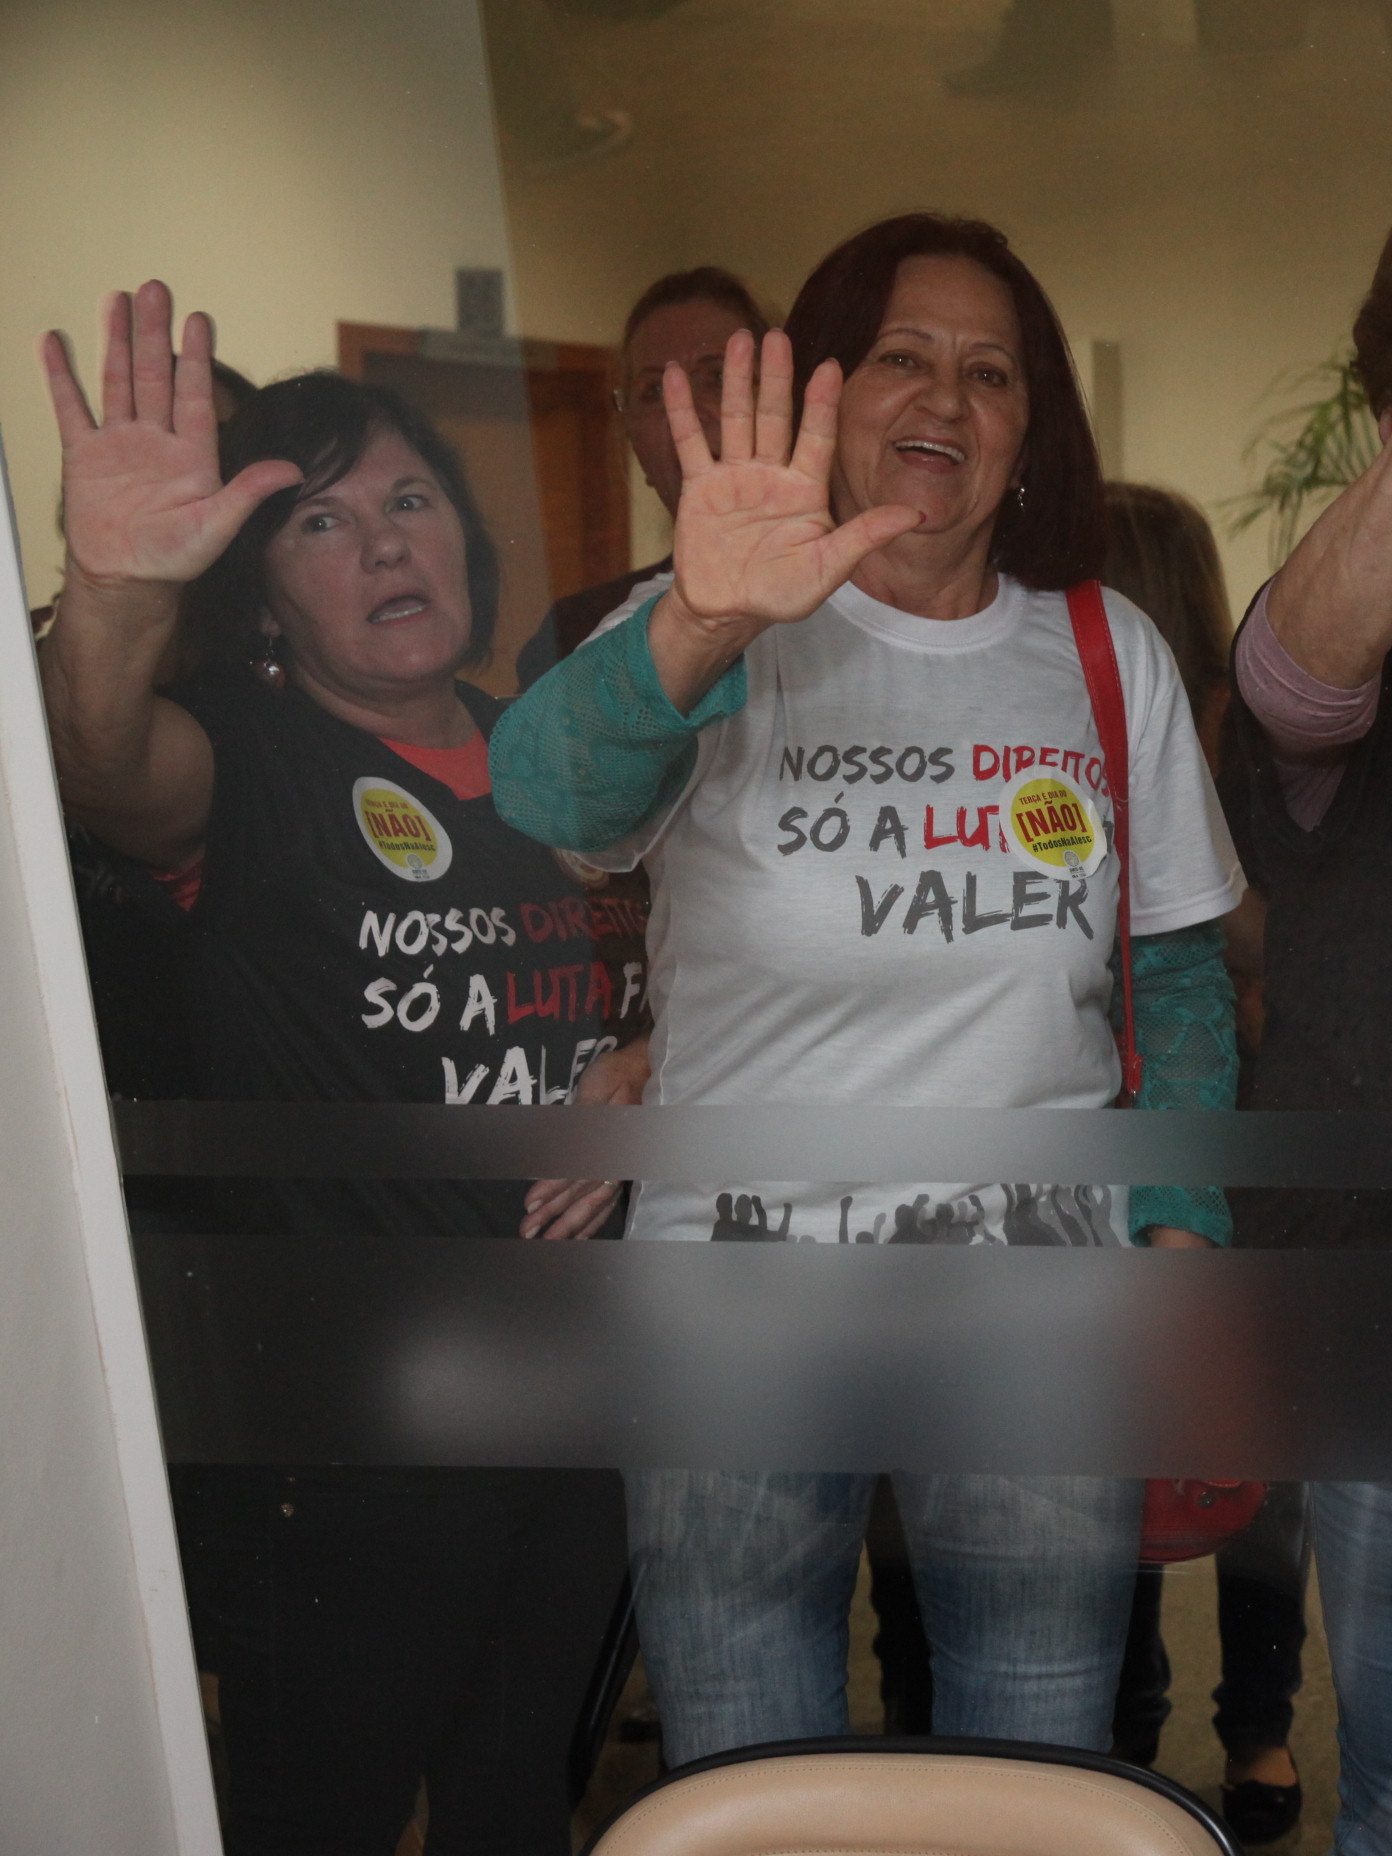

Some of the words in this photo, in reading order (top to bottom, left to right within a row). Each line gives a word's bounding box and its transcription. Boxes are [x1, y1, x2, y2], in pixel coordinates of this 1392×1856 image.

[778, 744, 955, 785] NOSSOS
[777, 791, 851, 857] SÓ
[868, 804, 909, 859] A
[1016, 800, 1087, 843] [NÃO]
[1032, 835, 1092, 853] #TodosNaAlesc
[855, 868, 1094, 944] VALER
[358, 907, 517, 957] NOSSOS
[361, 963, 441, 1032] SÓ
[459, 973, 498, 1037] A
[506, 961, 616, 1025] LUTA
